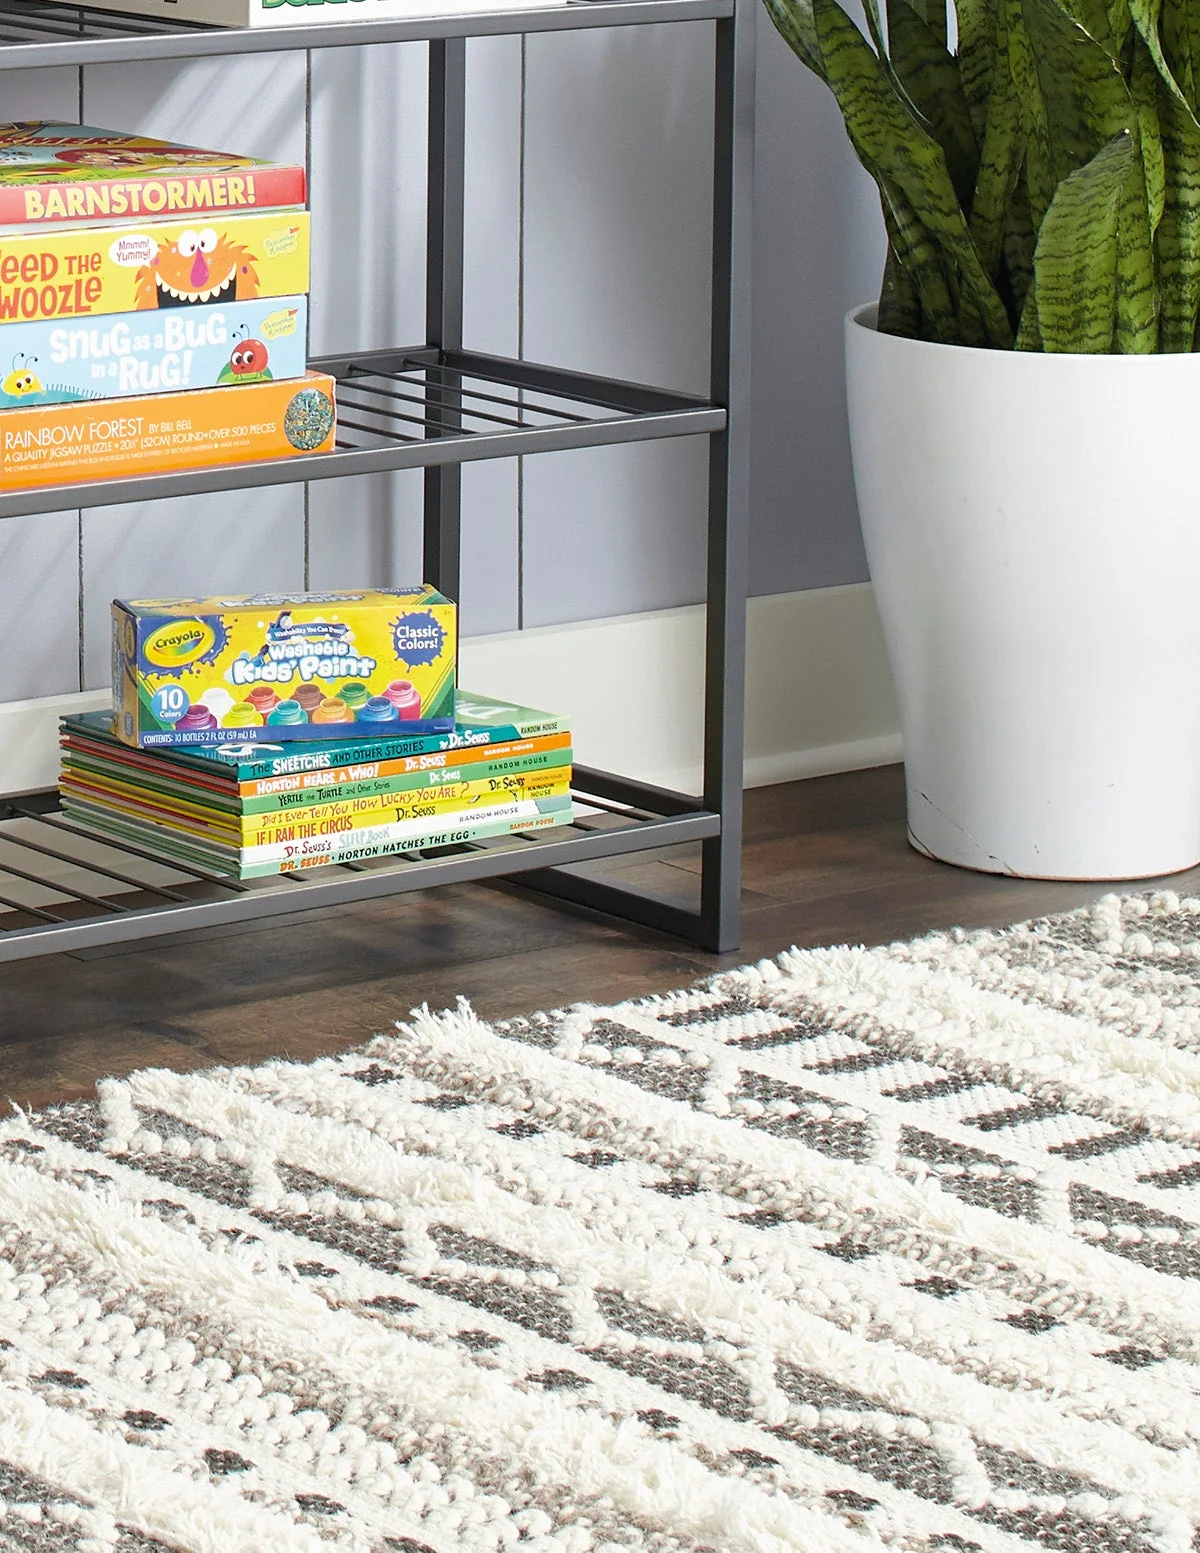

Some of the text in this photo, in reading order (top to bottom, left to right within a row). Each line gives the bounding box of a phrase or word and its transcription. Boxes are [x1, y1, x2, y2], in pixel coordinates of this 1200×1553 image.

[24, 176, 257, 220] BARNSTORMER!
[116, 249, 151, 262] Yummy!
[132, 333, 151, 349] as
[153, 336, 165, 349] a
[90, 363, 108, 380] in
[108, 362, 118, 377] a
[4, 453, 11, 463] A
[11, 449, 48, 463] QUALITY
[49, 444, 83, 460] JIGSAW
[84, 441, 112, 454] PUZZLE
[172, 431, 204, 444] ROUND
[208, 427, 230, 439] OVER
[231, 426, 248, 437] 500
[250, 422, 276, 434] PIECES
[5, 417, 192, 449] RAINBOW FOREST BY BILL BELL
[155, 629, 202, 648] Crayola
[396, 625, 439, 639] Classic
[397, 638, 438, 650] Colors!
[267, 639, 350, 658] Washable
[232, 655, 377, 685] Kids' Paint
[157, 689, 184, 710] 10
[159, 710, 182, 718] Colors
[143, 734, 173, 744] CONTENTS:
[182, 731, 205, 742] BOTTLES
[205, 731, 210, 741] 2
[210, 731, 217, 740] FL
[217, 731, 225, 740] OZ
[226, 730, 237, 741] (59
[237, 730, 248, 739] mL)
[249, 730, 257, 739] EA
[251, 762, 271, 776] The
[272, 753, 331, 775] SNEETCHES
[332, 752, 351, 764] AND
[353, 747, 382, 760] OTHER
[385, 741, 425, 756] STORIES
[448, 733, 464, 748] Dr.
[464, 729, 490, 745] Seuss
[520, 723, 541, 734] RANDOM
[542, 722, 558, 732] HOUSE
[256, 776, 300, 794] HORTON
[303, 772, 337, 788] HEARS
[338, 770, 348, 781] A
[347, 762, 380, 781] WHO!
[405, 758, 418, 771] Dr.
[419, 754, 447, 768] Seuss
[512, 743, 534, 752] HOUSE
[278, 793, 303, 807] YERTLE
[316, 787, 343, 800] TURTLE
[346, 787, 355, 795] and
[357, 784, 371, 793] Other
[429, 771, 440, 784] Dr.
[441, 769, 461, 782] Seuss
[488, 760, 520, 771] RANDOM
[522, 755, 548, 766] HOUSE
[262, 816, 276, 827] Did
[278, 813, 283, 823] I
[285, 810, 308, 822] Ever
[309, 808, 327, 819] Tell
[330, 804, 348, 817] You
[438, 786, 456, 798] ARE
[488, 779, 501, 791] Dr.
[503, 776, 525, 789] Seuss
[256, 832, 265, 846] IF
[268, 830, 271, 844] I
[275, 825, 295, 842] RAN
[298, 822, 316, 839] THE
[320, 816, 353, 835] CIRCUS
[396, 808, 410, 823] Dr.
[411, 805, 436, 819] Seuss
[284, 846, 300, 858] Dr.
[302, 840, 332, 854] Seuss's
[459, 809, 492, 823] RANDOM
[494, 806, 519, 816] HOUSE
[280, 860, 298, 872] DR.
[300, 855, 330, 868] SEUSS
[338, 848, 378, 861] HORTON
[382, 837, 425, 853] HATCHES
[429, 834, 446, 845] THE
[450, 830, 469, 842] EGG
